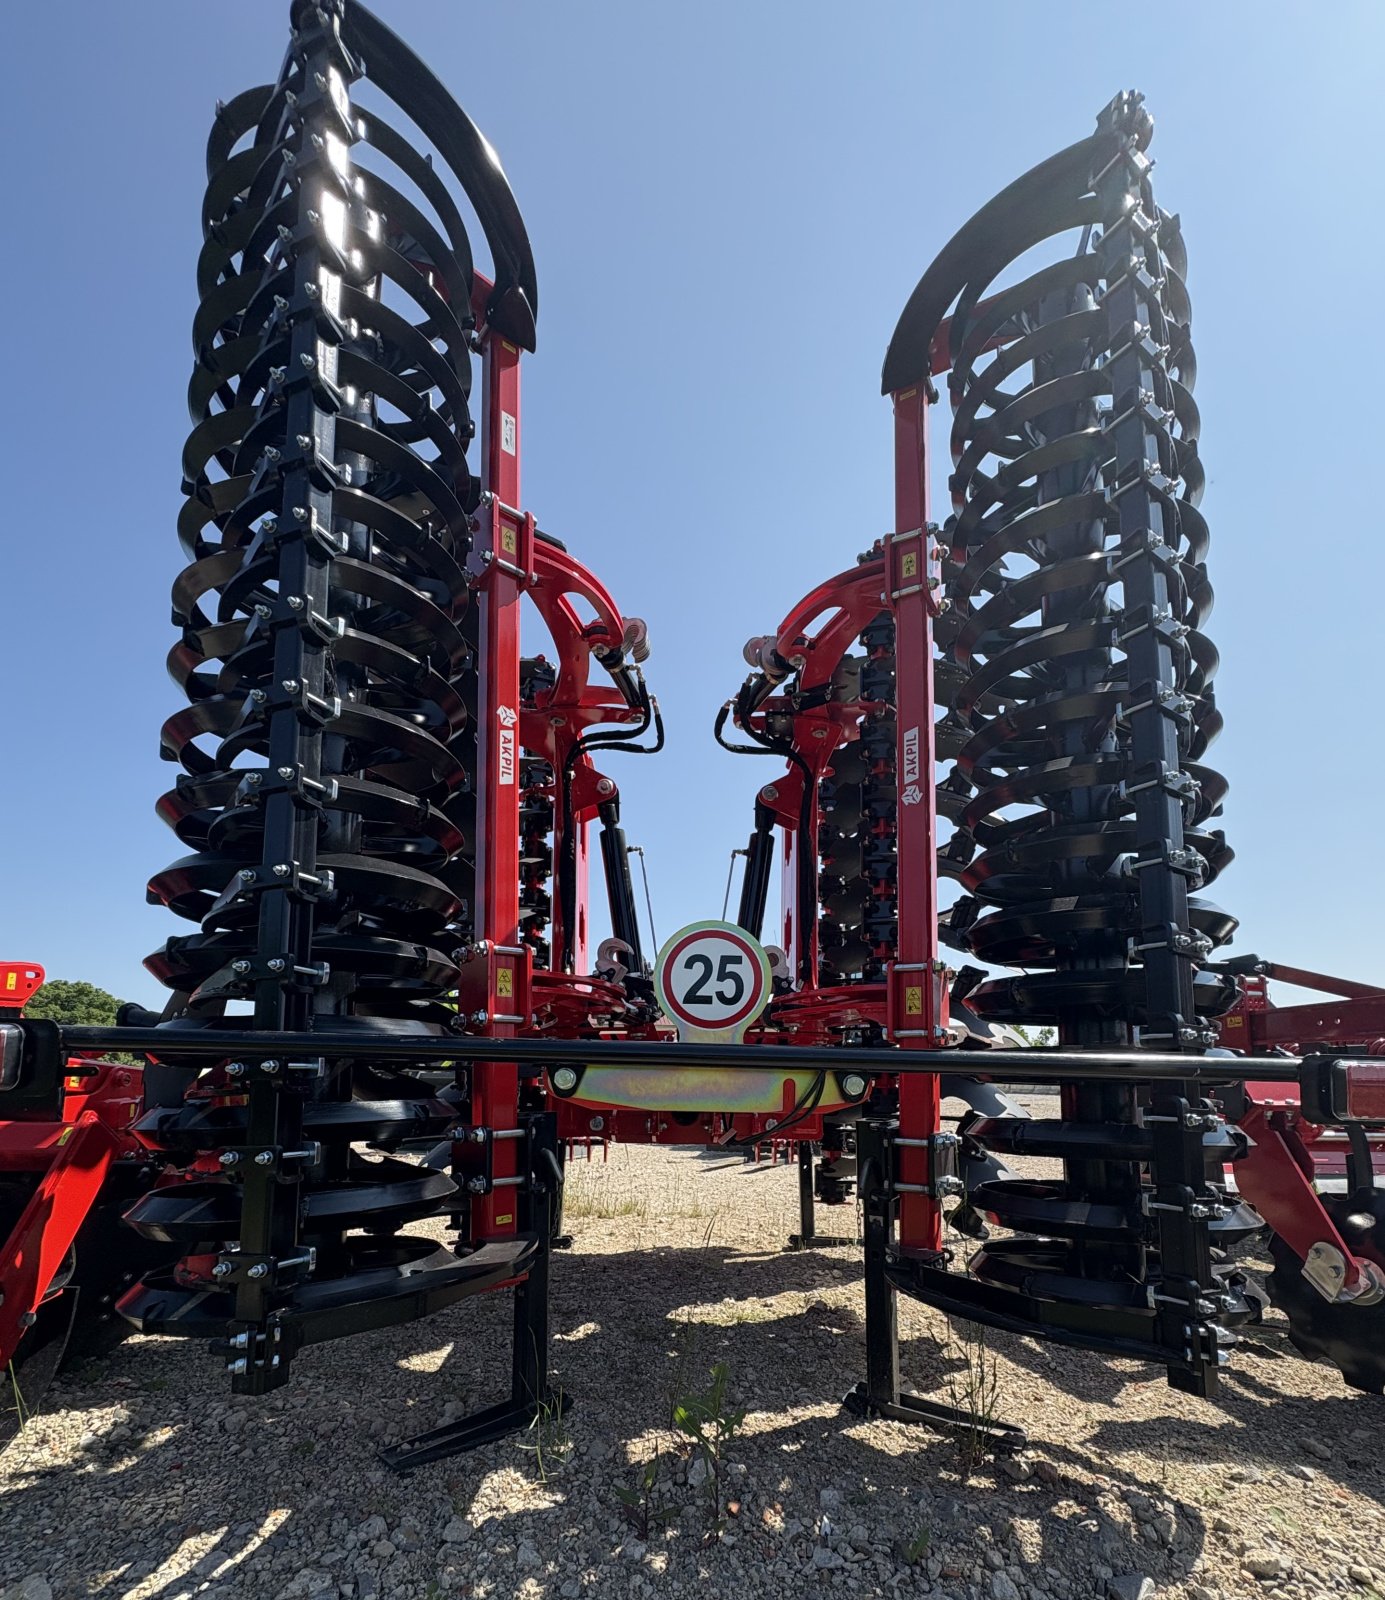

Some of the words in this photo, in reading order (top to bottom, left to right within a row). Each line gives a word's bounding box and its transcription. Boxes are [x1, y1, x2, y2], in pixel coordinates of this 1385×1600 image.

[501, 734, 512, 777] AKPIL
[906, 734, 917, 776] AKPIL
[682, 953, 745, 1006] 25
